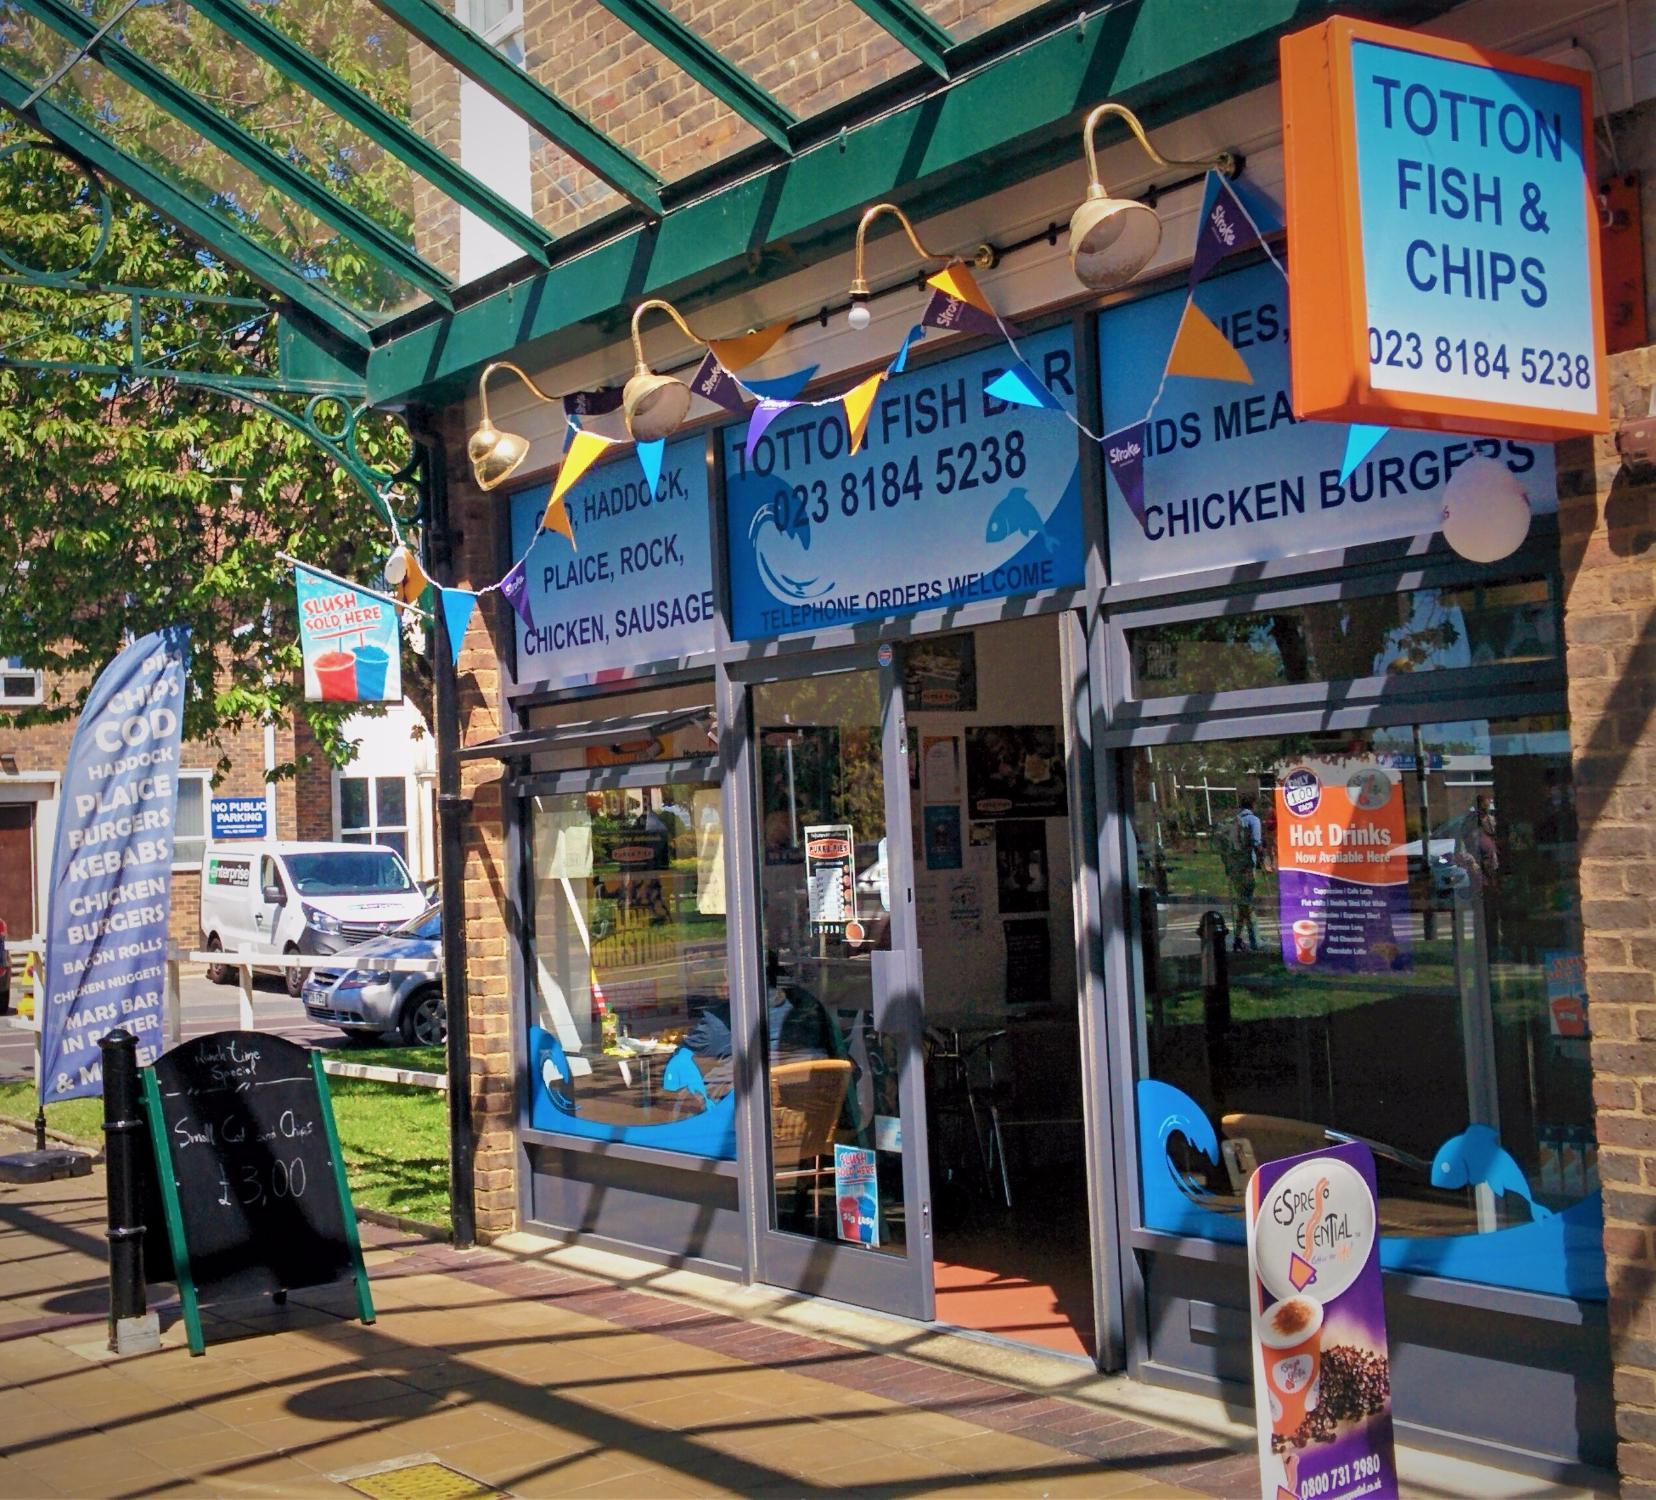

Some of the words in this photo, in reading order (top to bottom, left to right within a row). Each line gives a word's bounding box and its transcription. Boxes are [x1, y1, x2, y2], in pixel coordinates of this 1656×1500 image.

[1372, 75, 1562, 162] TOTTON
[1397, 158, 1502, 226] FISH
[1519, 182, 1551, 234] &
[1210, 204, 1236, 246] Stroke
[1406, 239, 1548, 308] CHIPS
[1368, 327, 1423, 370] 023
[1434, 335, 1510, 380] 8184
[1520, 347, 1591, 390] 5238
[882, 377, 966, 444] FISH
[982, 348, 1075, 418] BR
[1141, 411, 1201, 460] IDS
[1213, 390, 1306, 442] MEA
[1109, 441, 1141, 464] Stroke
[583, 467, 689, 525] HADDOCK,
[774, 478, 829, 531] 023
[840, 455, 923, 518] 8184
[936, 429, 1027, 494] 5238
[1143, 475, 1304, 541] CHICKEN
[543, 551, 614, 594] PLAICE,
[620, 533, 684, 577] ROCK,
[303, 592, 357, 615] SLUSH
[761, 595, 859, 633] TELEPHONE
[865, 581, 943, 615] ORDERS
[948, 560, 1055, 598] WELCOME
[305, 614, 341, 632] SOLD
[345, 606, 381, 624] HERE
[524, 613, 610, 656] CHICKEN,
[615, 590, 714, 638] SAUSAGE
[95, 708, 177, 753] COD
[88, 747, 174, 781] HADDOCK
[75, 774, 173, 818] PLAICE
[211, 802, 228, 812] NO
[229, 801, 268, 812] PUBLIC
[216, 812, 263, 823] PARKING
[68, 807, 170, 850] BURGERS
[1289, 824, 1323, 847] Hot
[1328, 822, 1392, 847] Drinks
[69, 838, 168, 883] KEBABS
[1295, 851, 1317, 863] Now
[1319, 850, 1364, 864] Available
[1367, 849, 1390, 863] Here
[69, 877, 166, 917] CHICKEN
[67, 903, 165, 945] BURGERS
[63, 949, 115, 976] BACON
[118, 937, 162, 960] ROLLS
[53, 980, 106, 1005] CHICKEN
[108, 965, 162, 989] NUGGETS
[66, 1002, 118, 1031] MARS
[121, 991, 160, 1015] BAR
[61, 1035, 85, 1056] IN
[56, 1072, 75, 1094] &
[1301, 1472, 1329, 1500] 0800
[1330, 1464, 1351, 1489] 731
[1352, 1453, 1380, 1481] 2980
